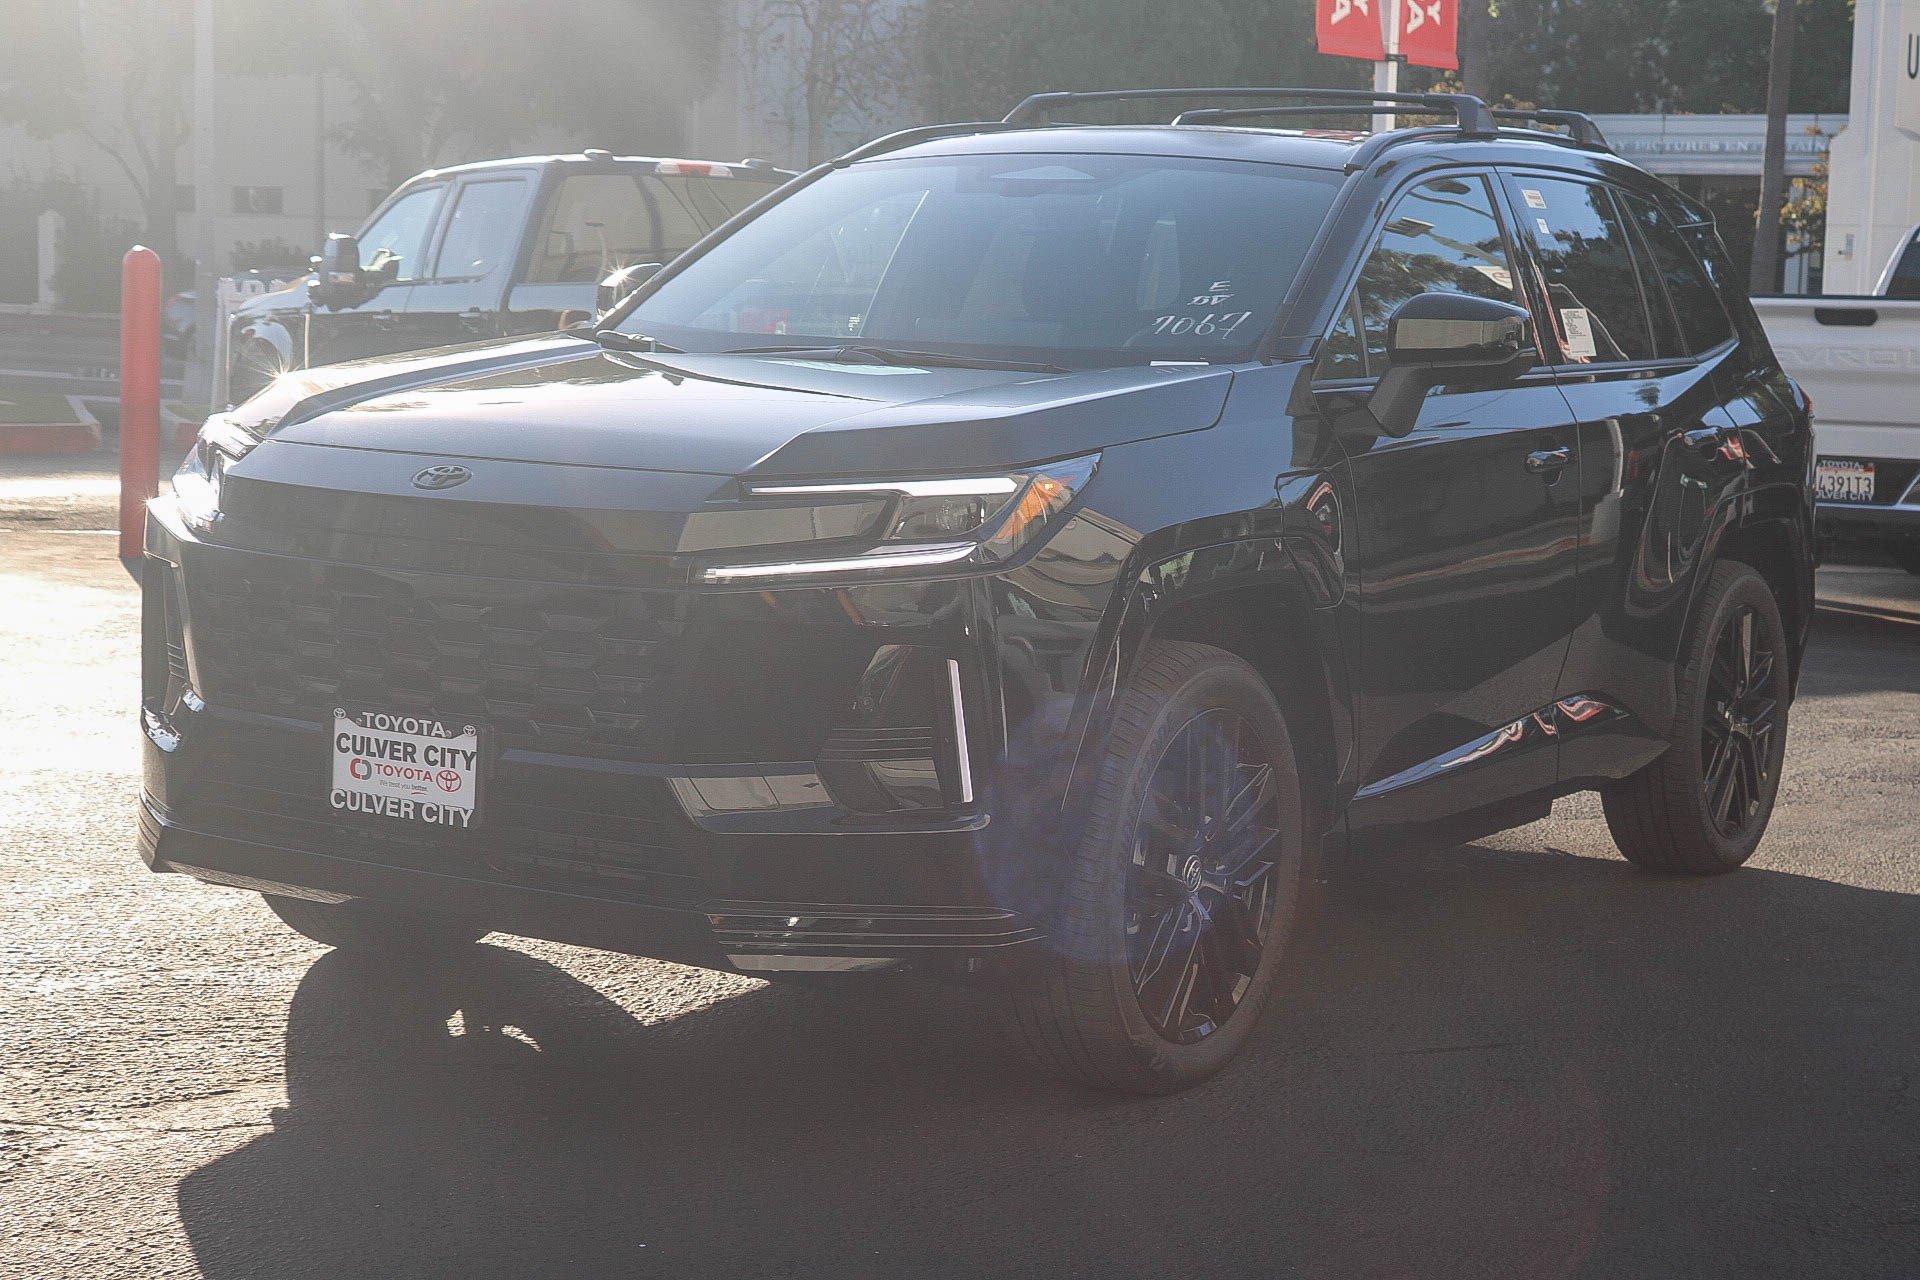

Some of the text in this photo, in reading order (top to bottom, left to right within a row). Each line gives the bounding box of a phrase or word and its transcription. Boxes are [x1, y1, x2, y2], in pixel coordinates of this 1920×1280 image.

[1820, 460, 1860, 470] TOYOTA
[362, 711, 446, 738] TOYOTA
[336, 732, 477, 771] CULVER CITY
[375, 763, 433, 782] TOYOTA
[330, 788, 473, 829] CULVER CITY
